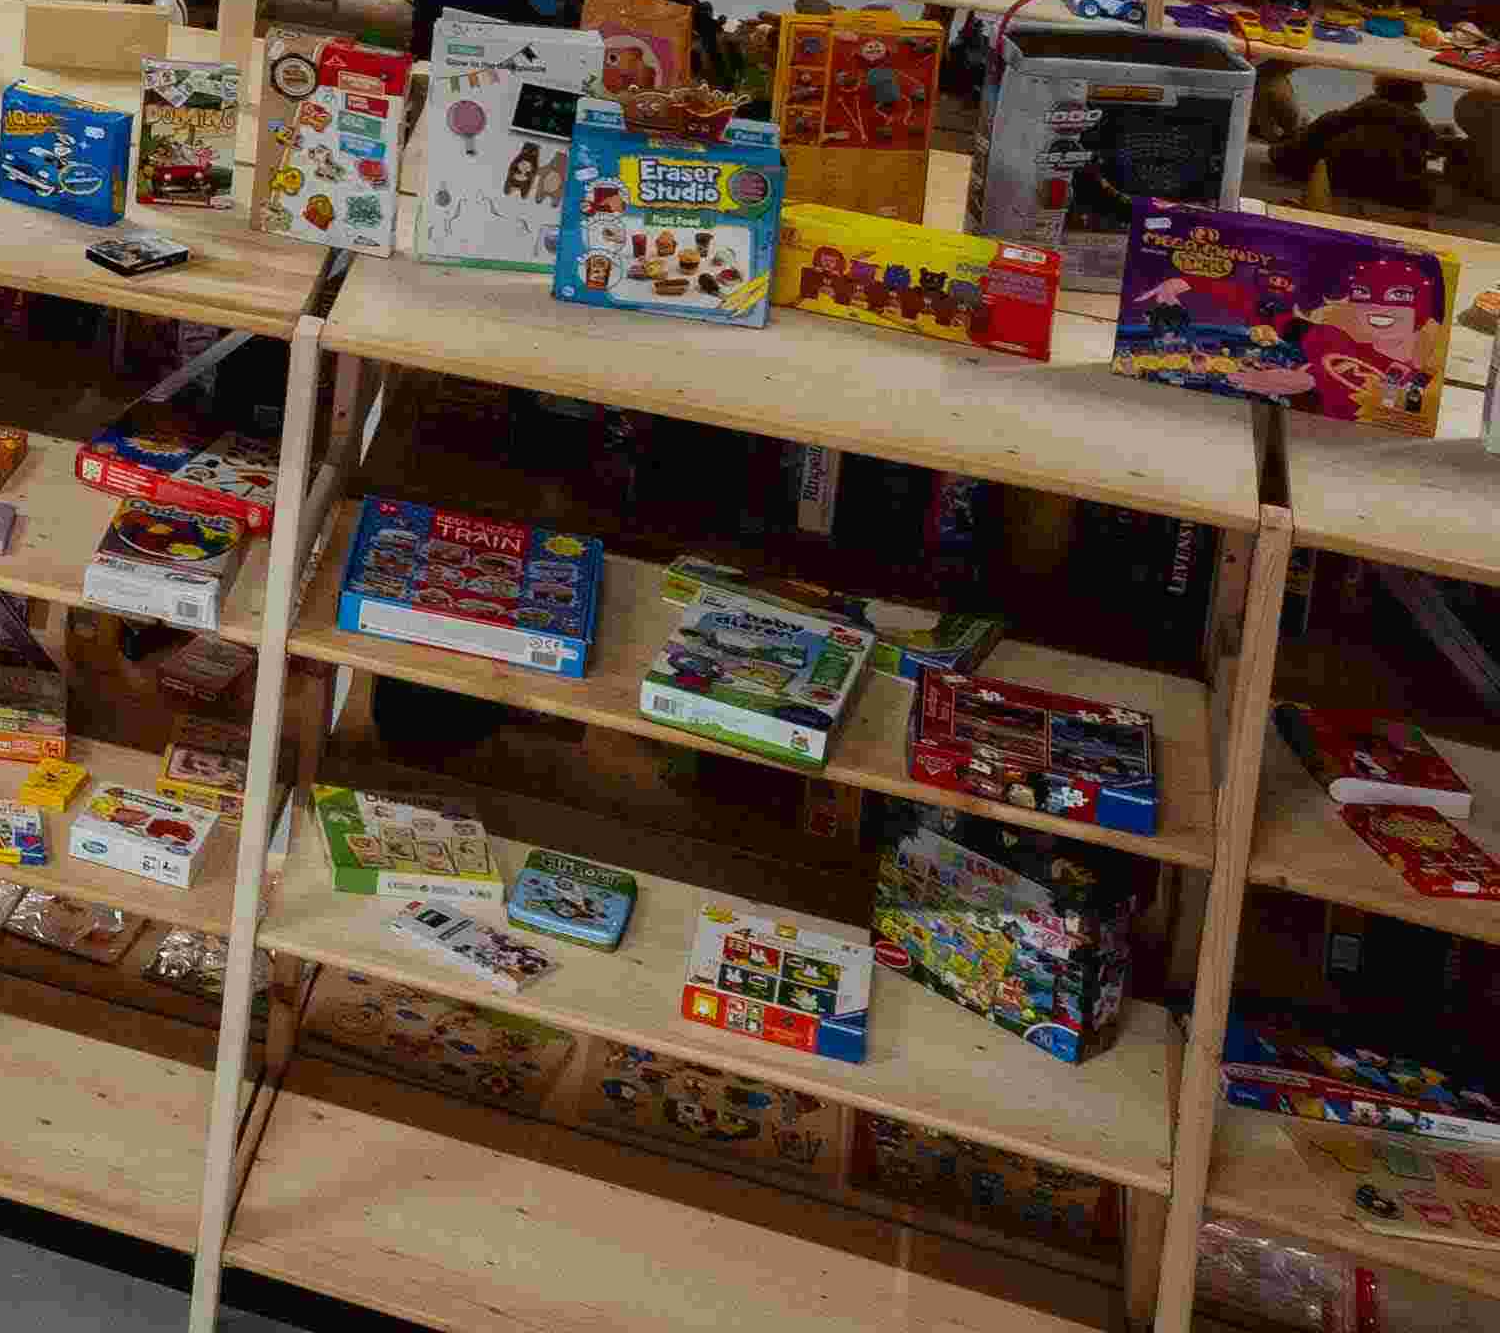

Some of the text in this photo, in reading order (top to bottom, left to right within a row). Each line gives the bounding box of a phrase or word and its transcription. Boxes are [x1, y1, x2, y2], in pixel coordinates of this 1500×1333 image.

[639, 158, 720, 183] Eraser
[639, 182, 720, 203] Studio
[441, 523, 524, 552] TRAIN
